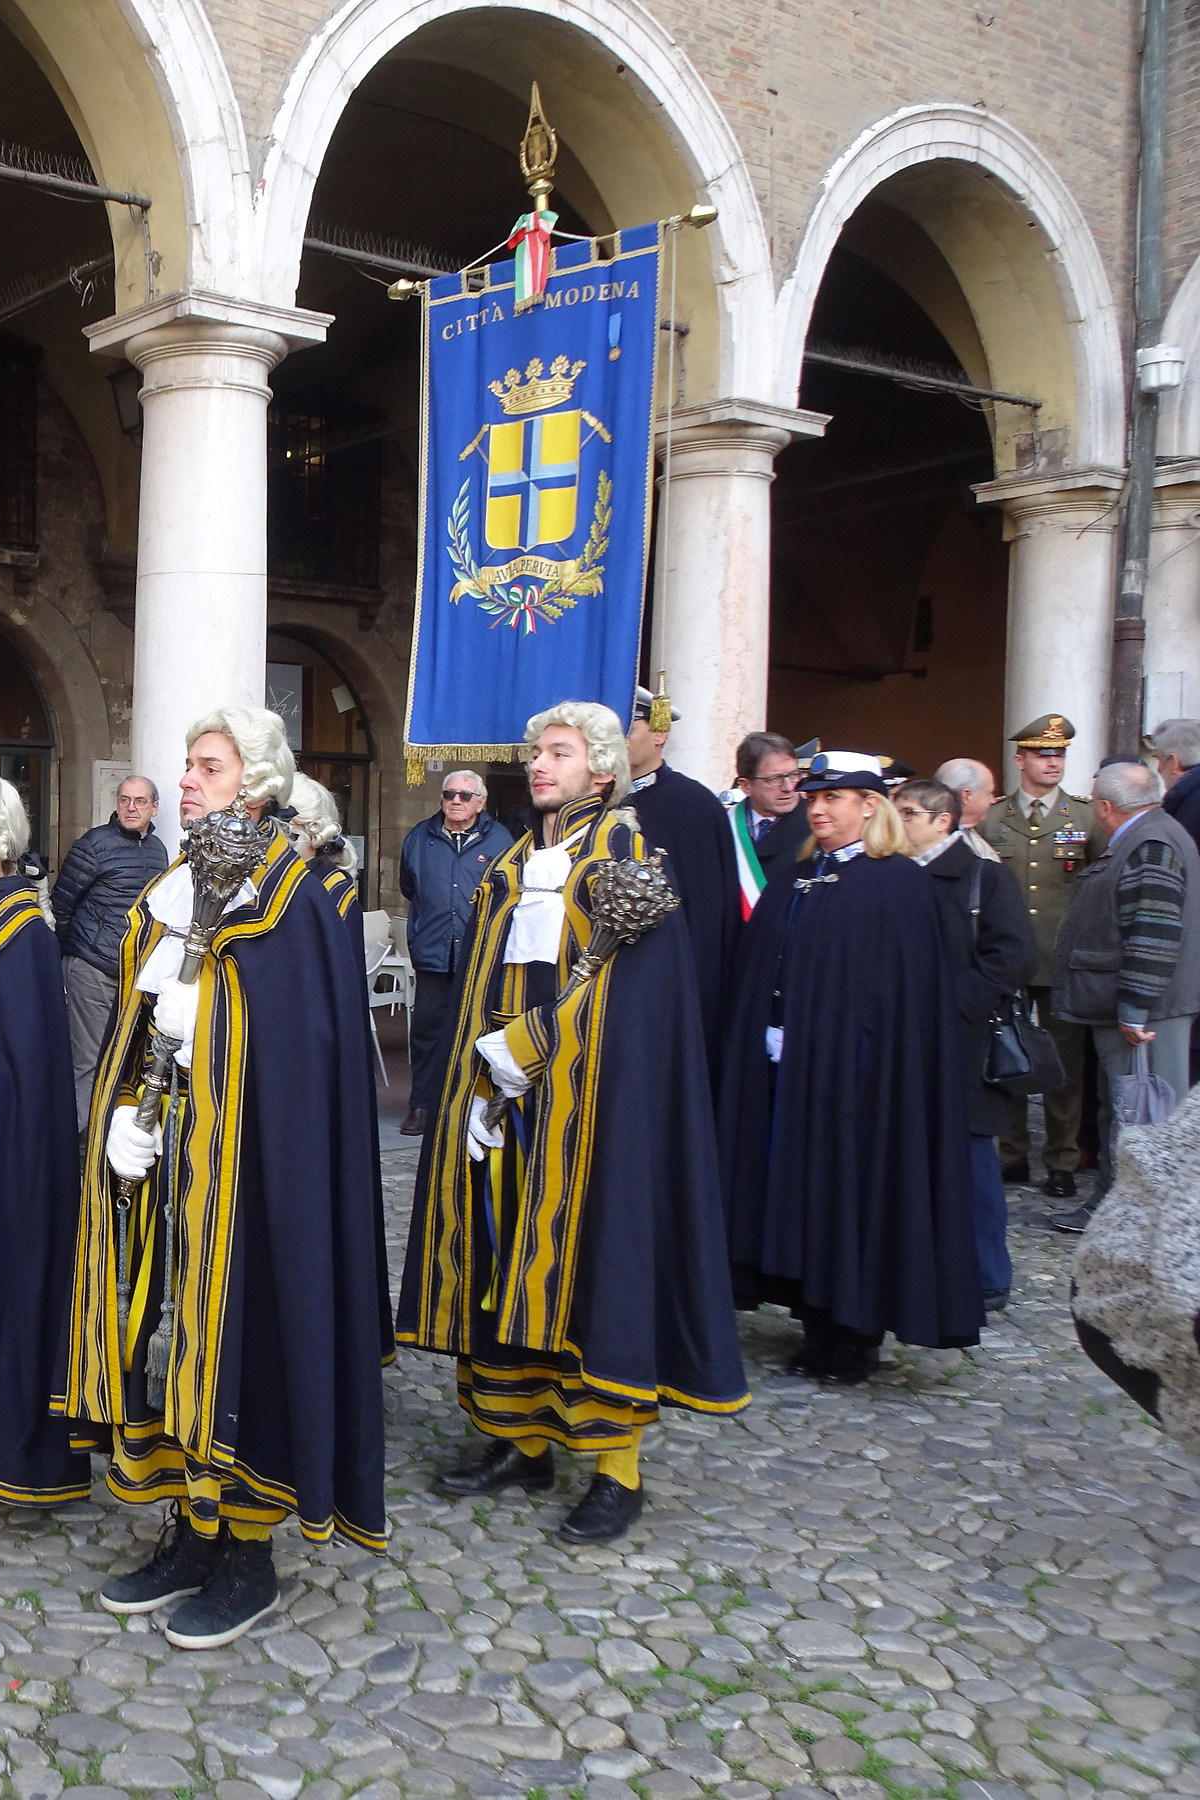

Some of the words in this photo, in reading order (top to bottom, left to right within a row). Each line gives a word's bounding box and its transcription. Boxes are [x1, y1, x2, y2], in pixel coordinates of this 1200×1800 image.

[441, 303, 504, 340] CITTÀ
[544, 280, 640, 310] MODENA
[493, 563, 519, 582] AVIA
[519, 559, 560, 577] PERVIA
